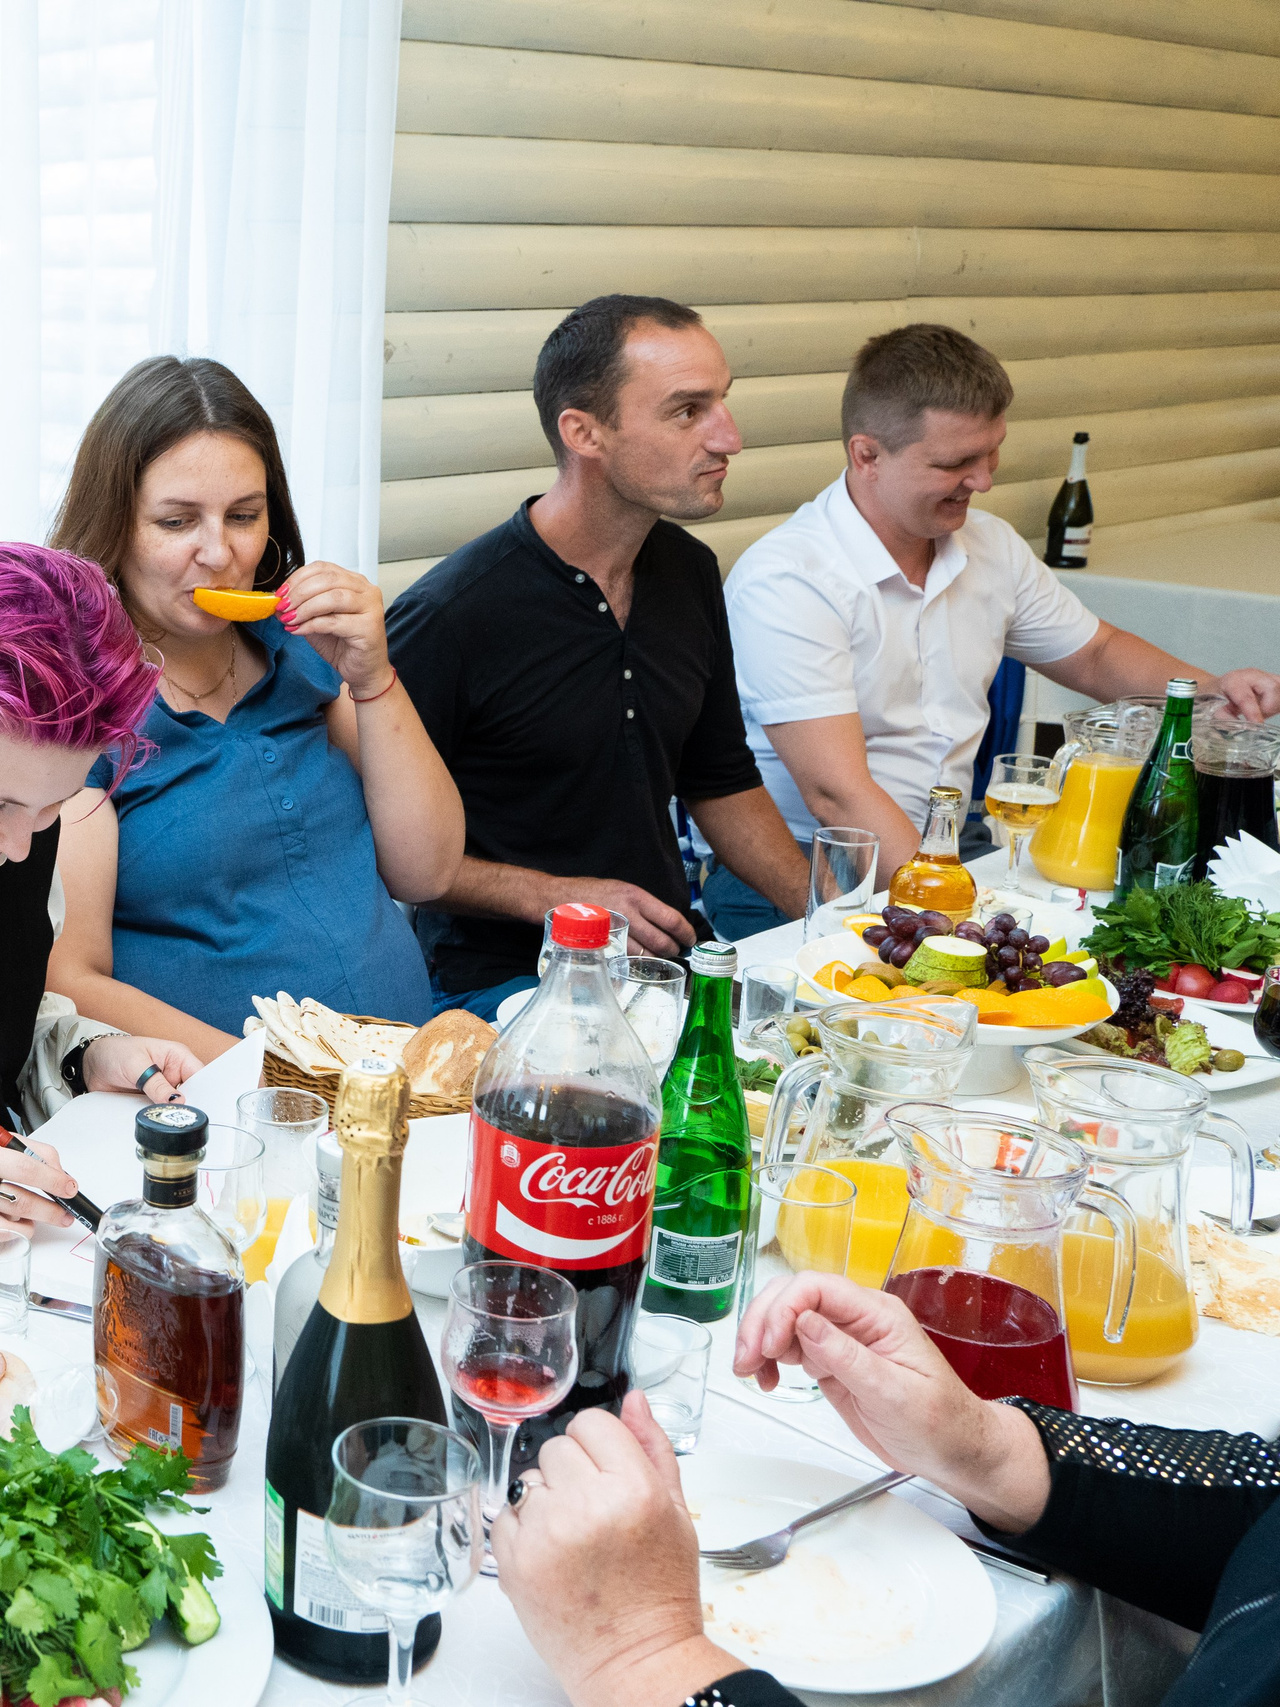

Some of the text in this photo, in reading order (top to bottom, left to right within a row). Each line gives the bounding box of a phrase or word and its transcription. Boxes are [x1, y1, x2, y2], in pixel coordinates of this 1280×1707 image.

[519, 1142, 657, 1208] Coca-Cola
[587, 1218, 594, 1226] с
[597, 1213, 617, 1225] 1886
